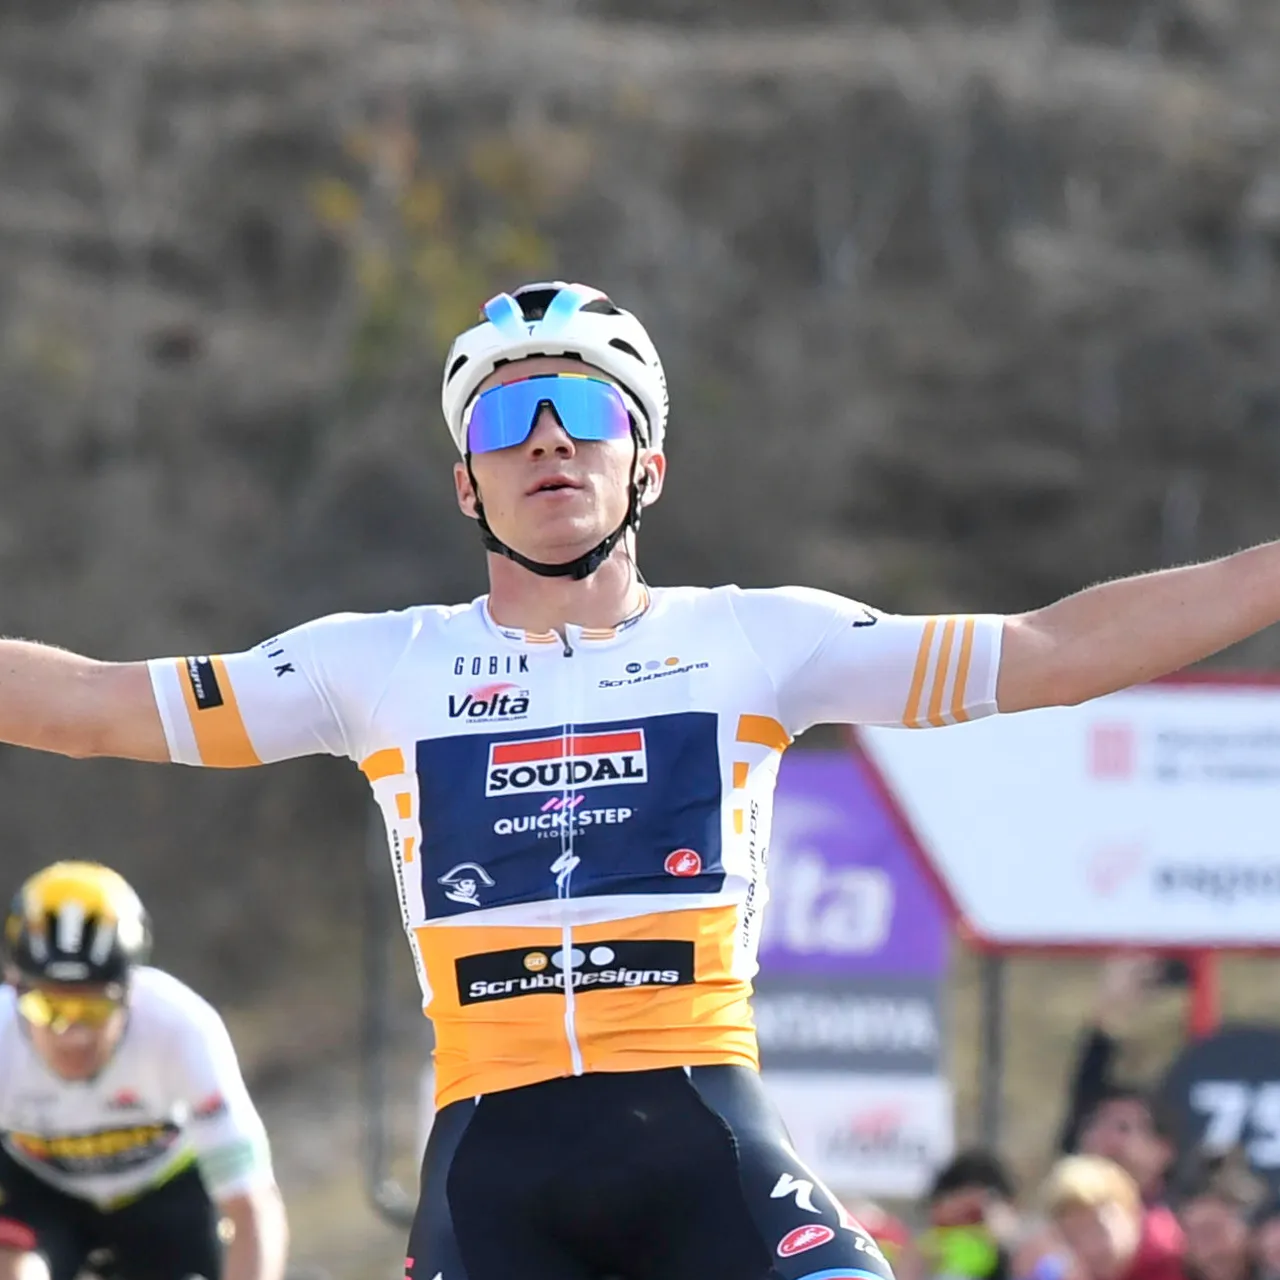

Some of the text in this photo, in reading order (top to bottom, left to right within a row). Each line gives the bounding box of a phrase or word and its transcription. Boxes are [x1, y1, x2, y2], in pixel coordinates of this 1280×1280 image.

[454, 655, 529, 676] GOBIK
[448, 692, 529, 718] Volta
[489, 756, 643, 791] SOUDAL
[493, 808, 632, 835] QUICK-STEP
[469, 967, 679, 997] ScrubDesigns
